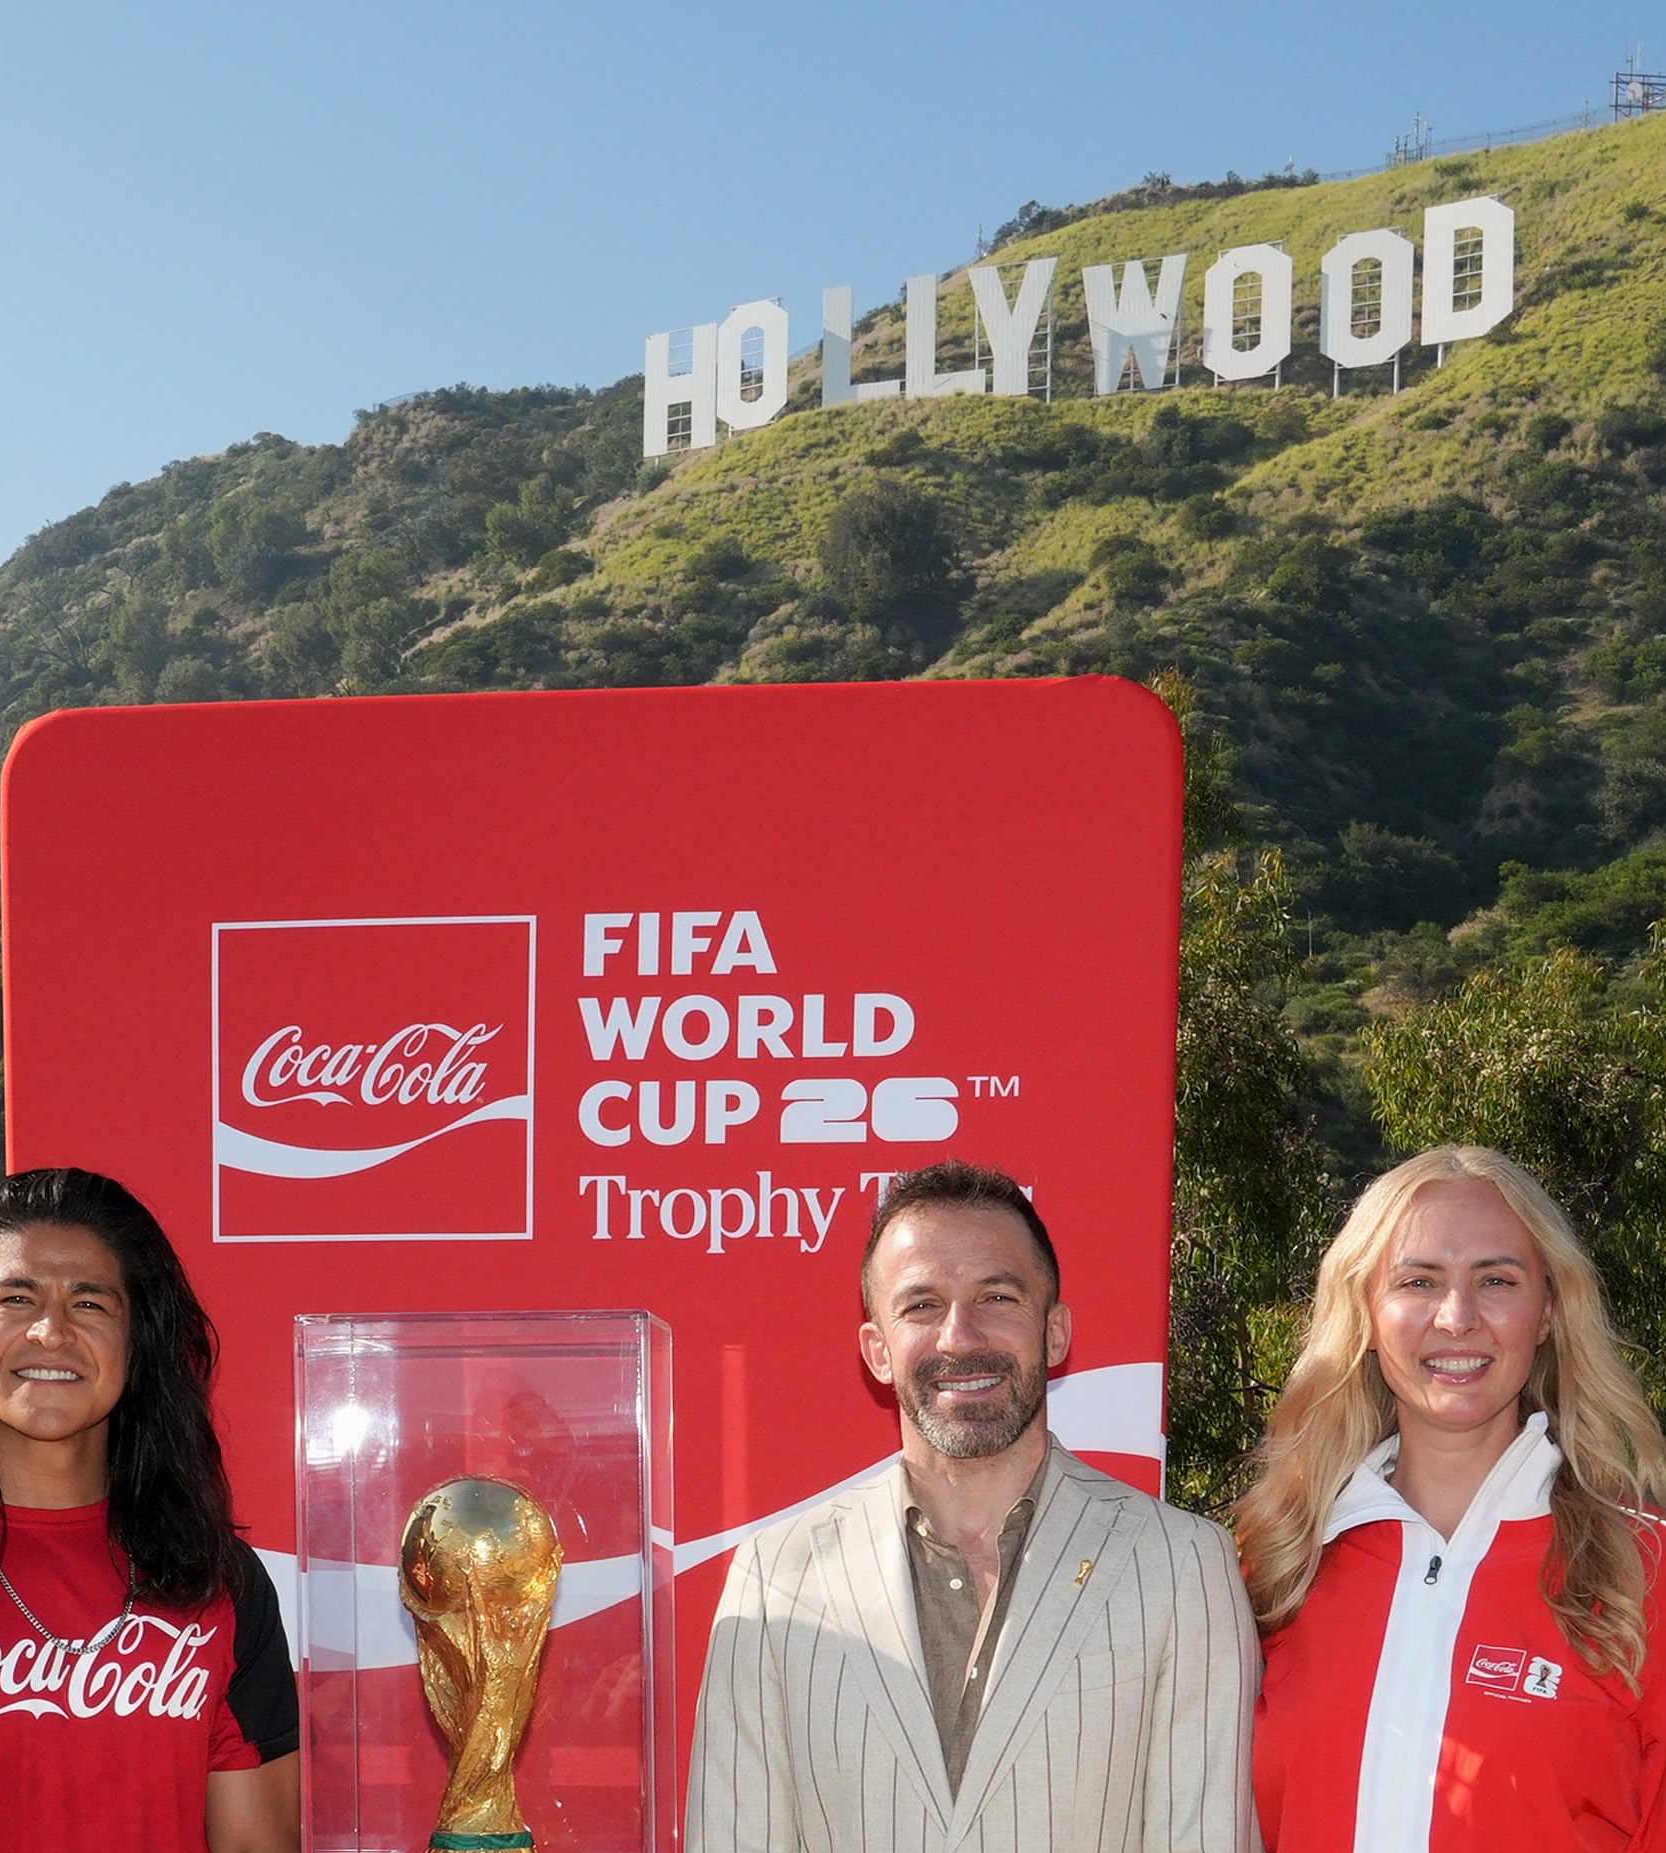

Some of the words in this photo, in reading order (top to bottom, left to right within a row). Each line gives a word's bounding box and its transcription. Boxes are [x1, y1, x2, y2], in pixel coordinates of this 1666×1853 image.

[644, 194, 1515, 458] HOLLYWOOD
[583, 910, 777, 976] FIFA
[578, 992, 915, 1061] WORLD
[241, 1023, 504, 1108] Coca-Cola
[578, 1079, 761, 1147] CUP
[579, 1170, 845, 1254] Trophy
[1532, 1686, 1547, 1694] FIFA
